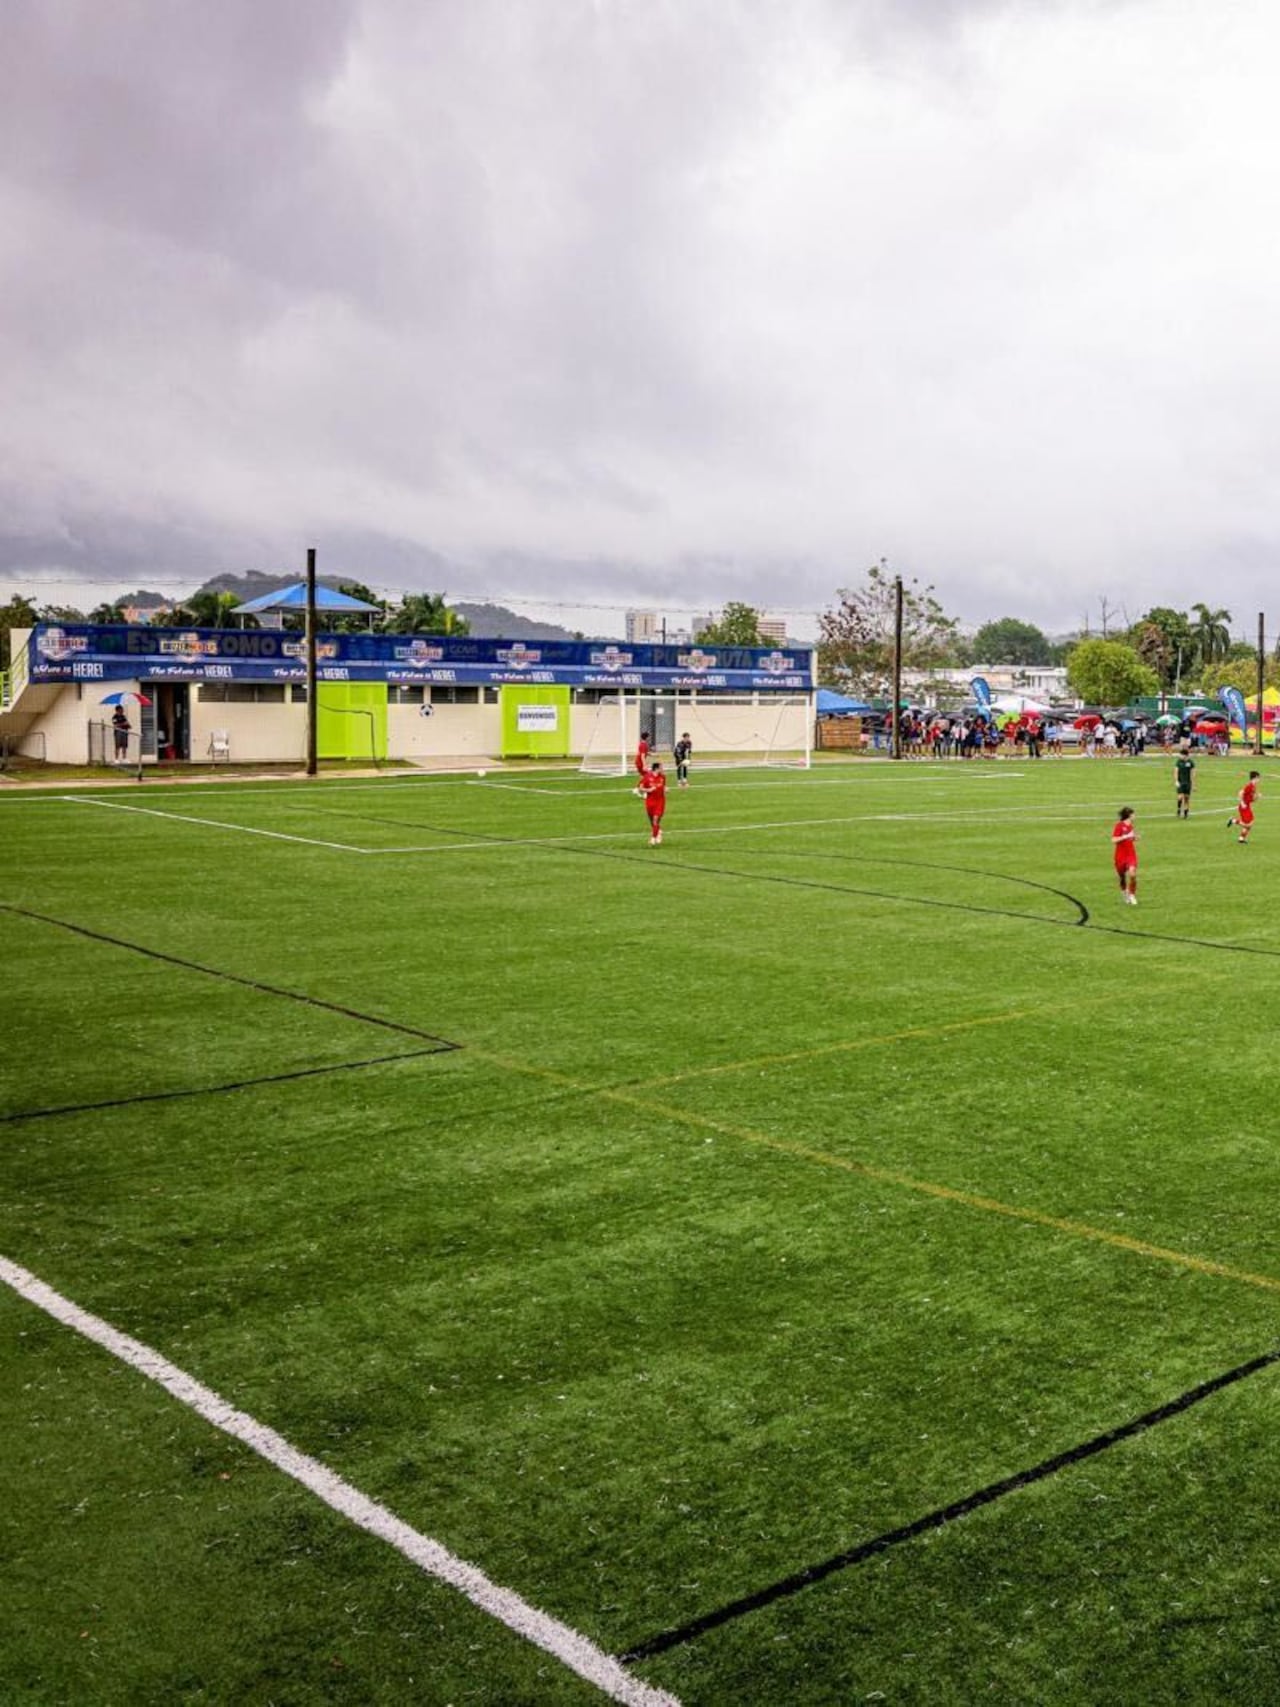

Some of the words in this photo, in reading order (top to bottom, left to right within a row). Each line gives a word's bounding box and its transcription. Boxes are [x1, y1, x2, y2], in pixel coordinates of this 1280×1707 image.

[73, 663, 104, 678] HERE!
[149, 666, 165, 675] The
[168, 666, 194, 676] Future
[204, 665, 232, 678] HERE!
[273, 668, 289, 677] The
[323, 668, 349, 680] HERE!
[387, 671, 400, 679] The
[431, 669, 456, 682] HERE!
[532, 671, 555, 683] HERE!
